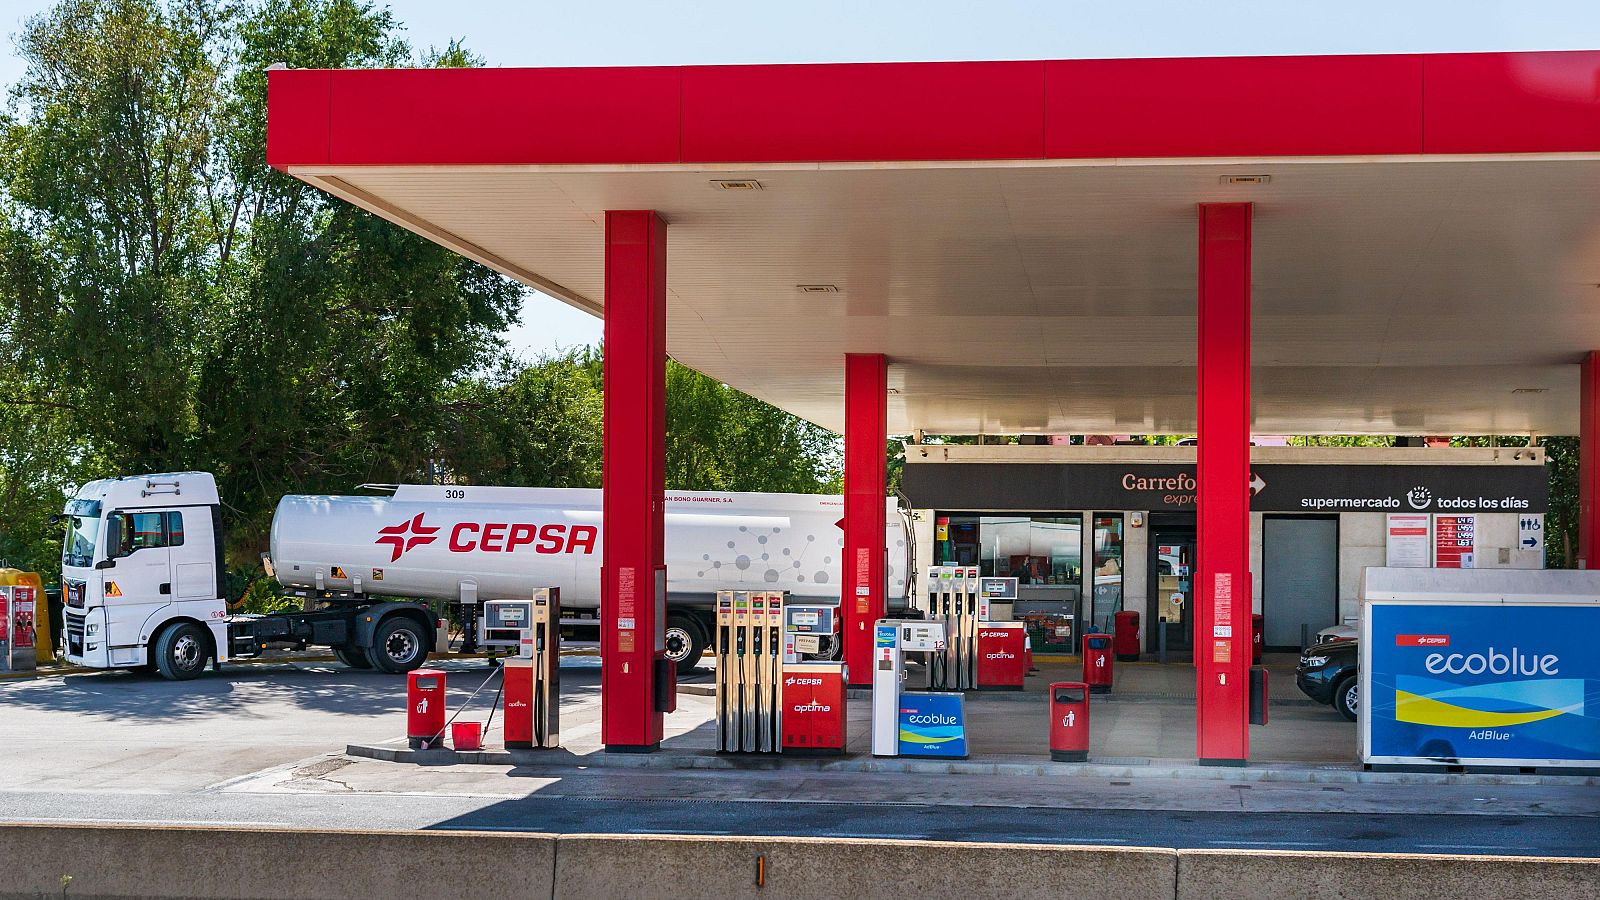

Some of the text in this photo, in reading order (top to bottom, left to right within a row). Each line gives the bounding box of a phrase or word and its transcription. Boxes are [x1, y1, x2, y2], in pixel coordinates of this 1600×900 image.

[1122, 473, 1197, 490] Carrefo
[445, 490, 465, 499] 309
[1163, 493, 1198, 506] expre
[1414, 491, 1425, 499] 24
[1301, 496, 1529, 509] supermercado todos los días
[449, 523, 598, 554] CEPSA
[934, 640, 945, 649] 12
[986, 653, 1014, 661] optima
[1425, 647, 1559, 676] ecoblue
[794, 704, 830, 714] optima
[909, 714, 957, 725] ecoblue
[1468, 730, 1510, 740] AdBlue
